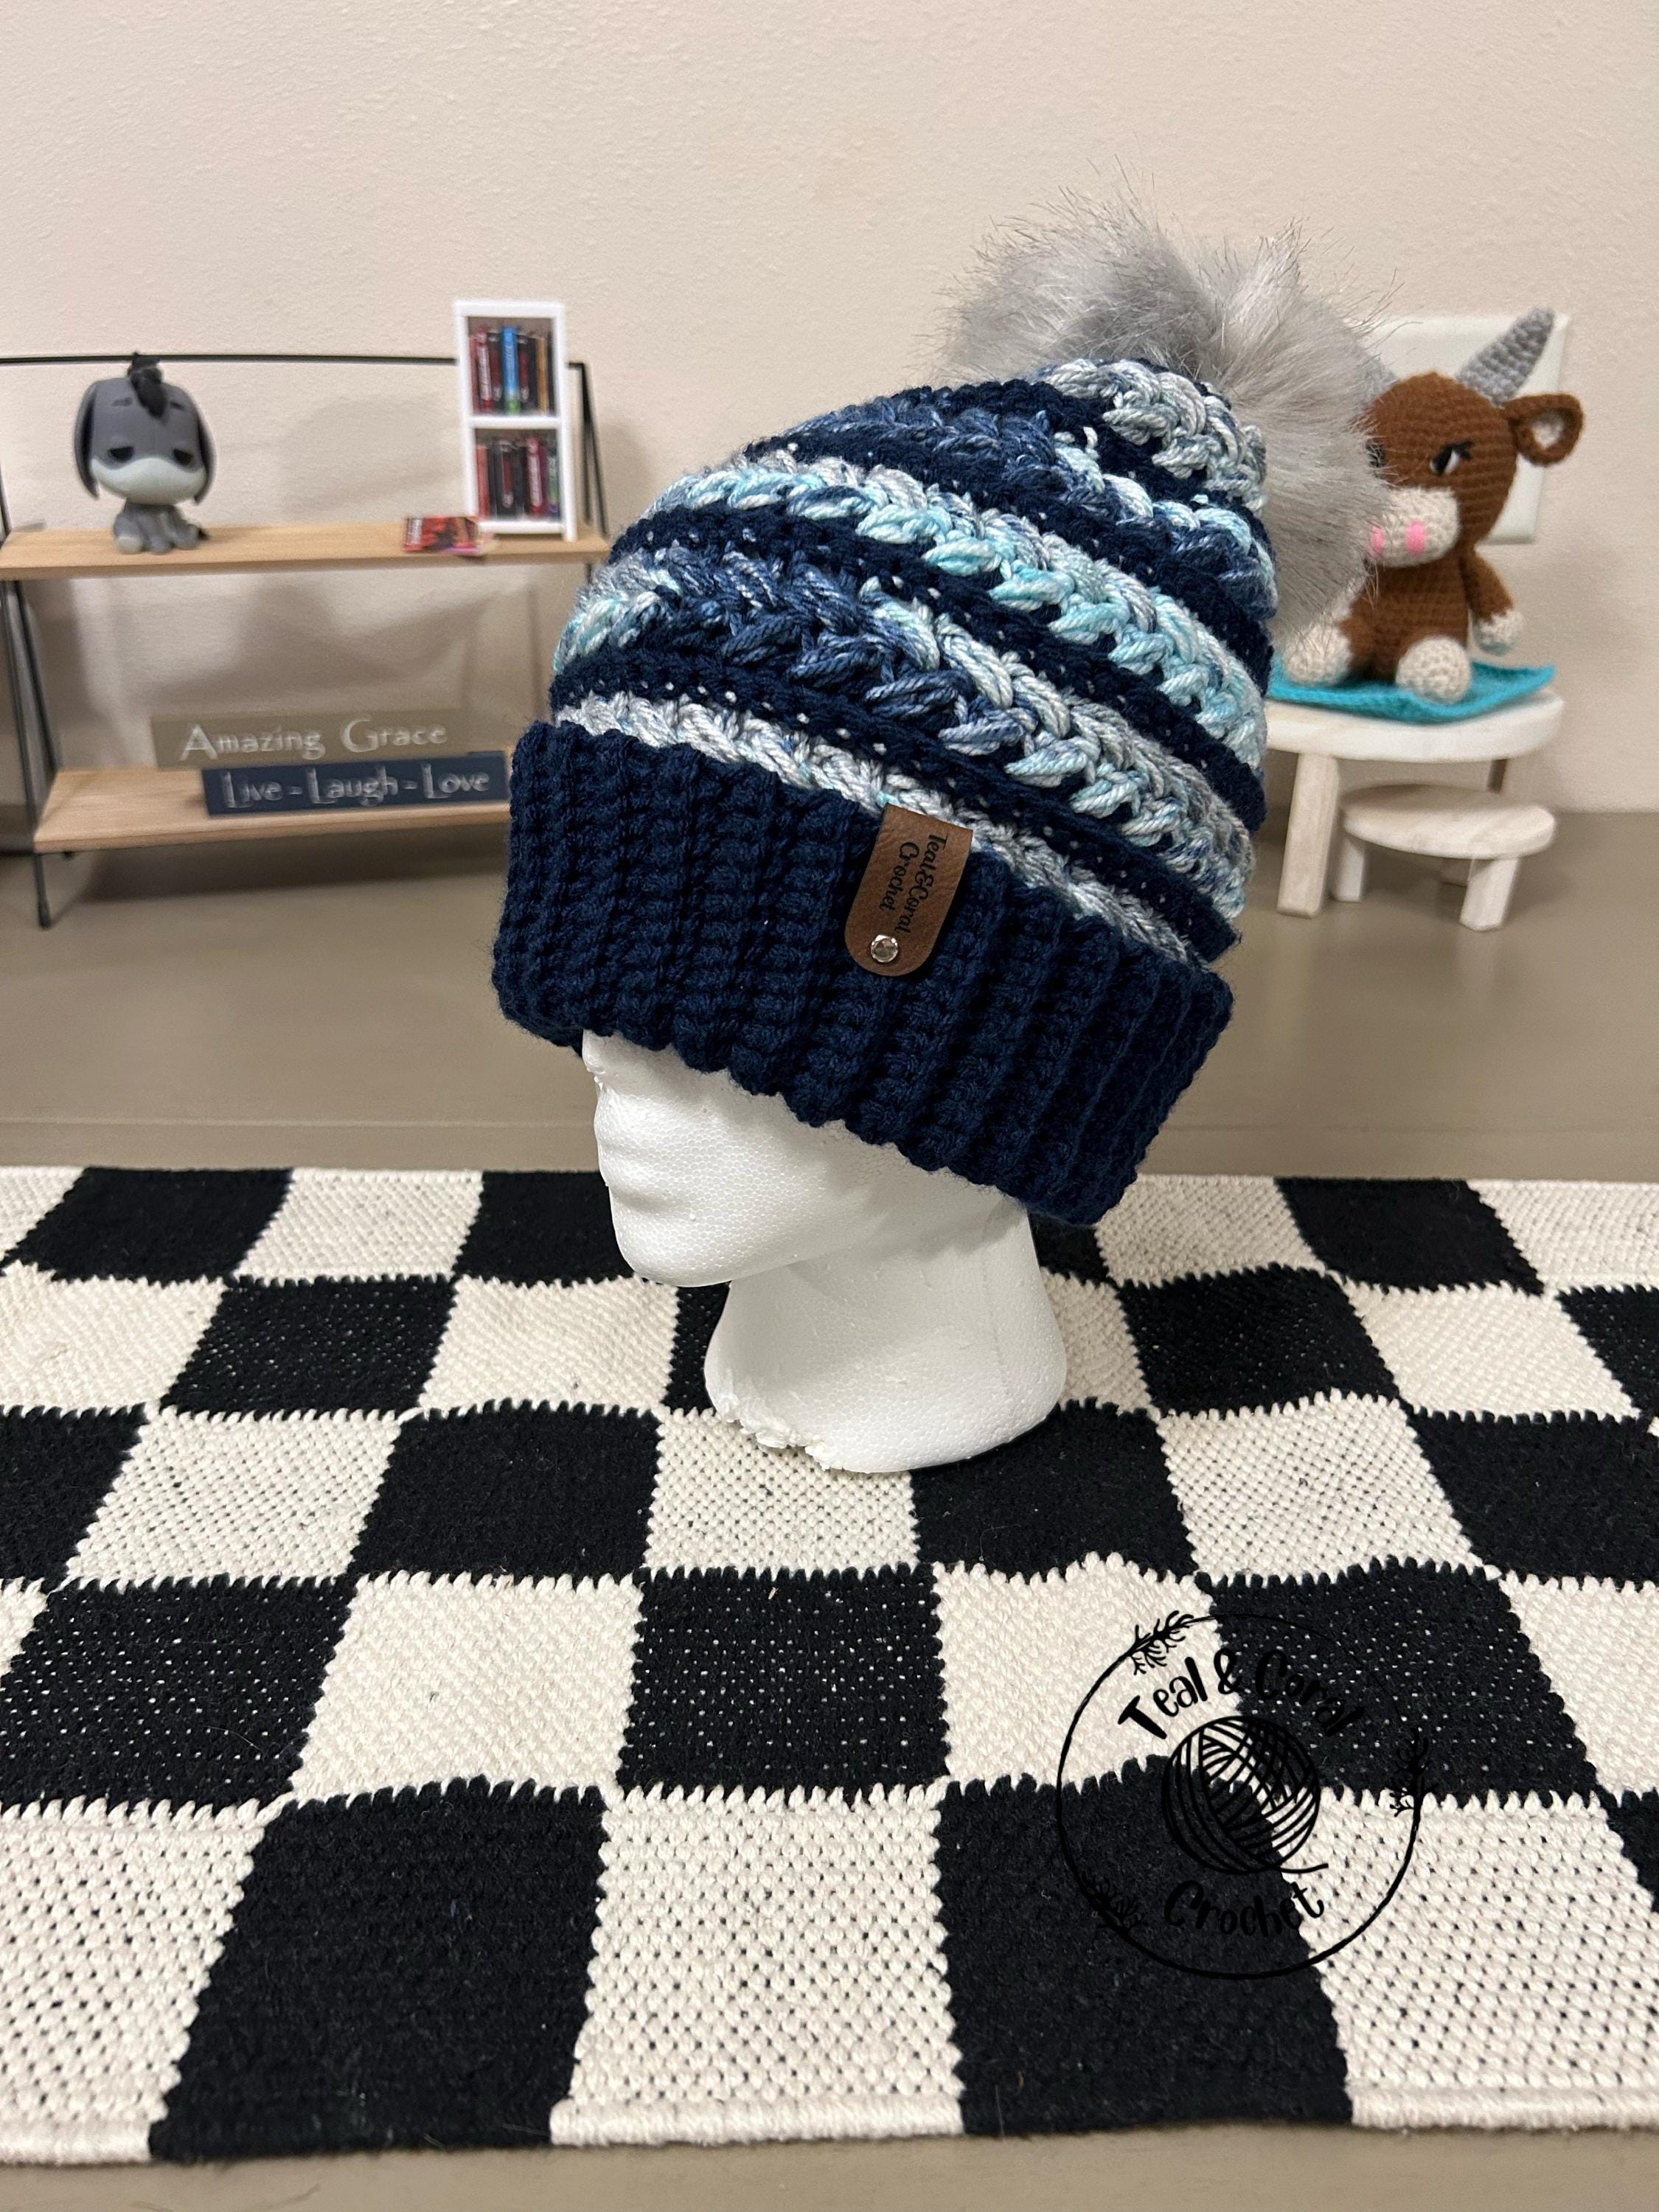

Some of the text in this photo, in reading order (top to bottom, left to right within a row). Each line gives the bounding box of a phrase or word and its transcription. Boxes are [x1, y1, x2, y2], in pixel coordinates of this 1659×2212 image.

[180, 718, 448, 760] Amazing Grace
[879, 841, 920, 911] Crochet
